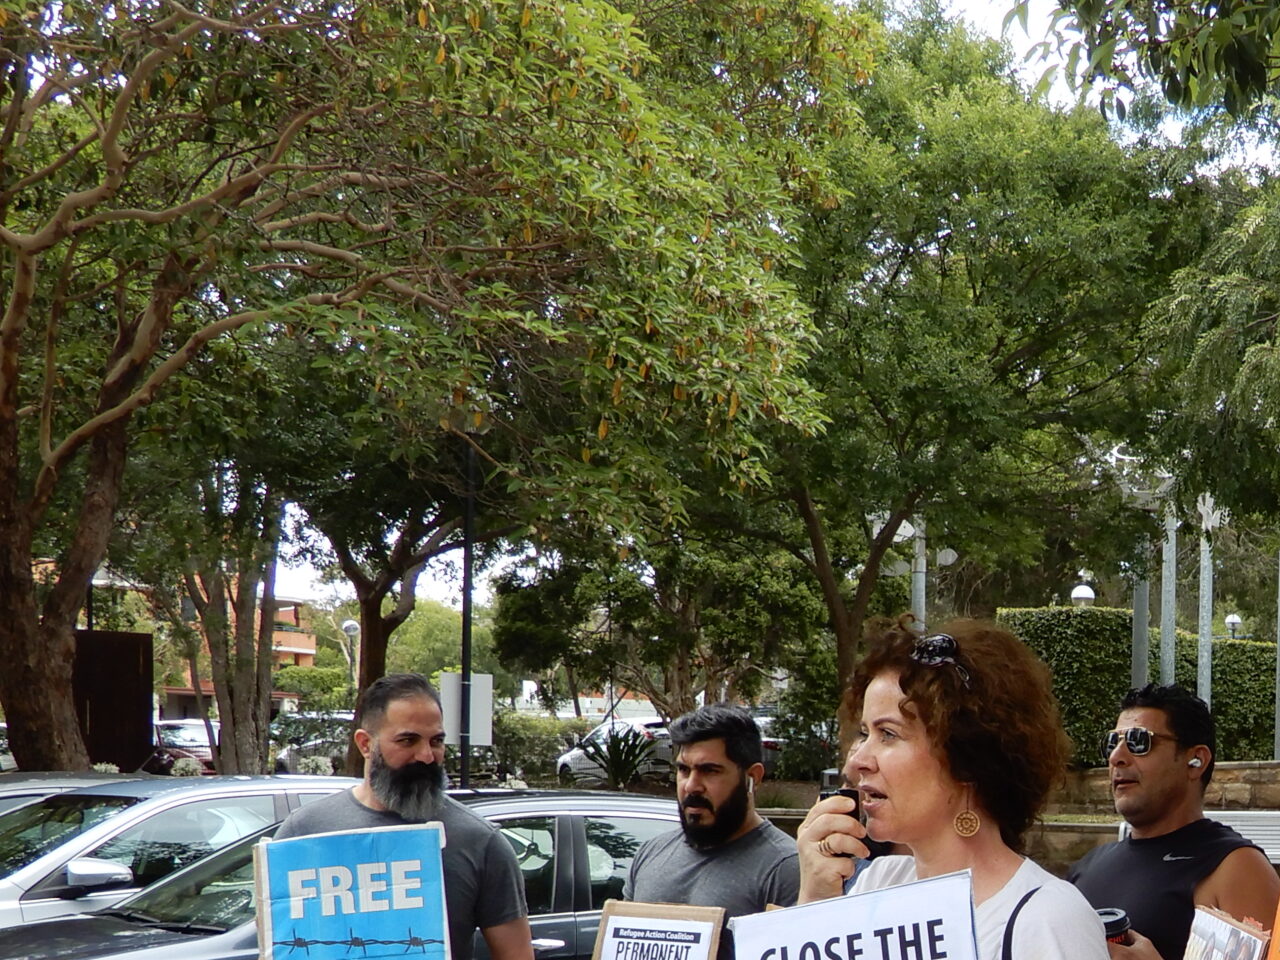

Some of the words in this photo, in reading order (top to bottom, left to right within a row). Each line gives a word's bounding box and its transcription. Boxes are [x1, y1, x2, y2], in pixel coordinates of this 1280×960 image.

[287, 859, 424, 919] FREE
[619, 928, 644, 939] Refugee
[645, 930, 665, 939] Action
[666, 932, 695, 941] Coalition
